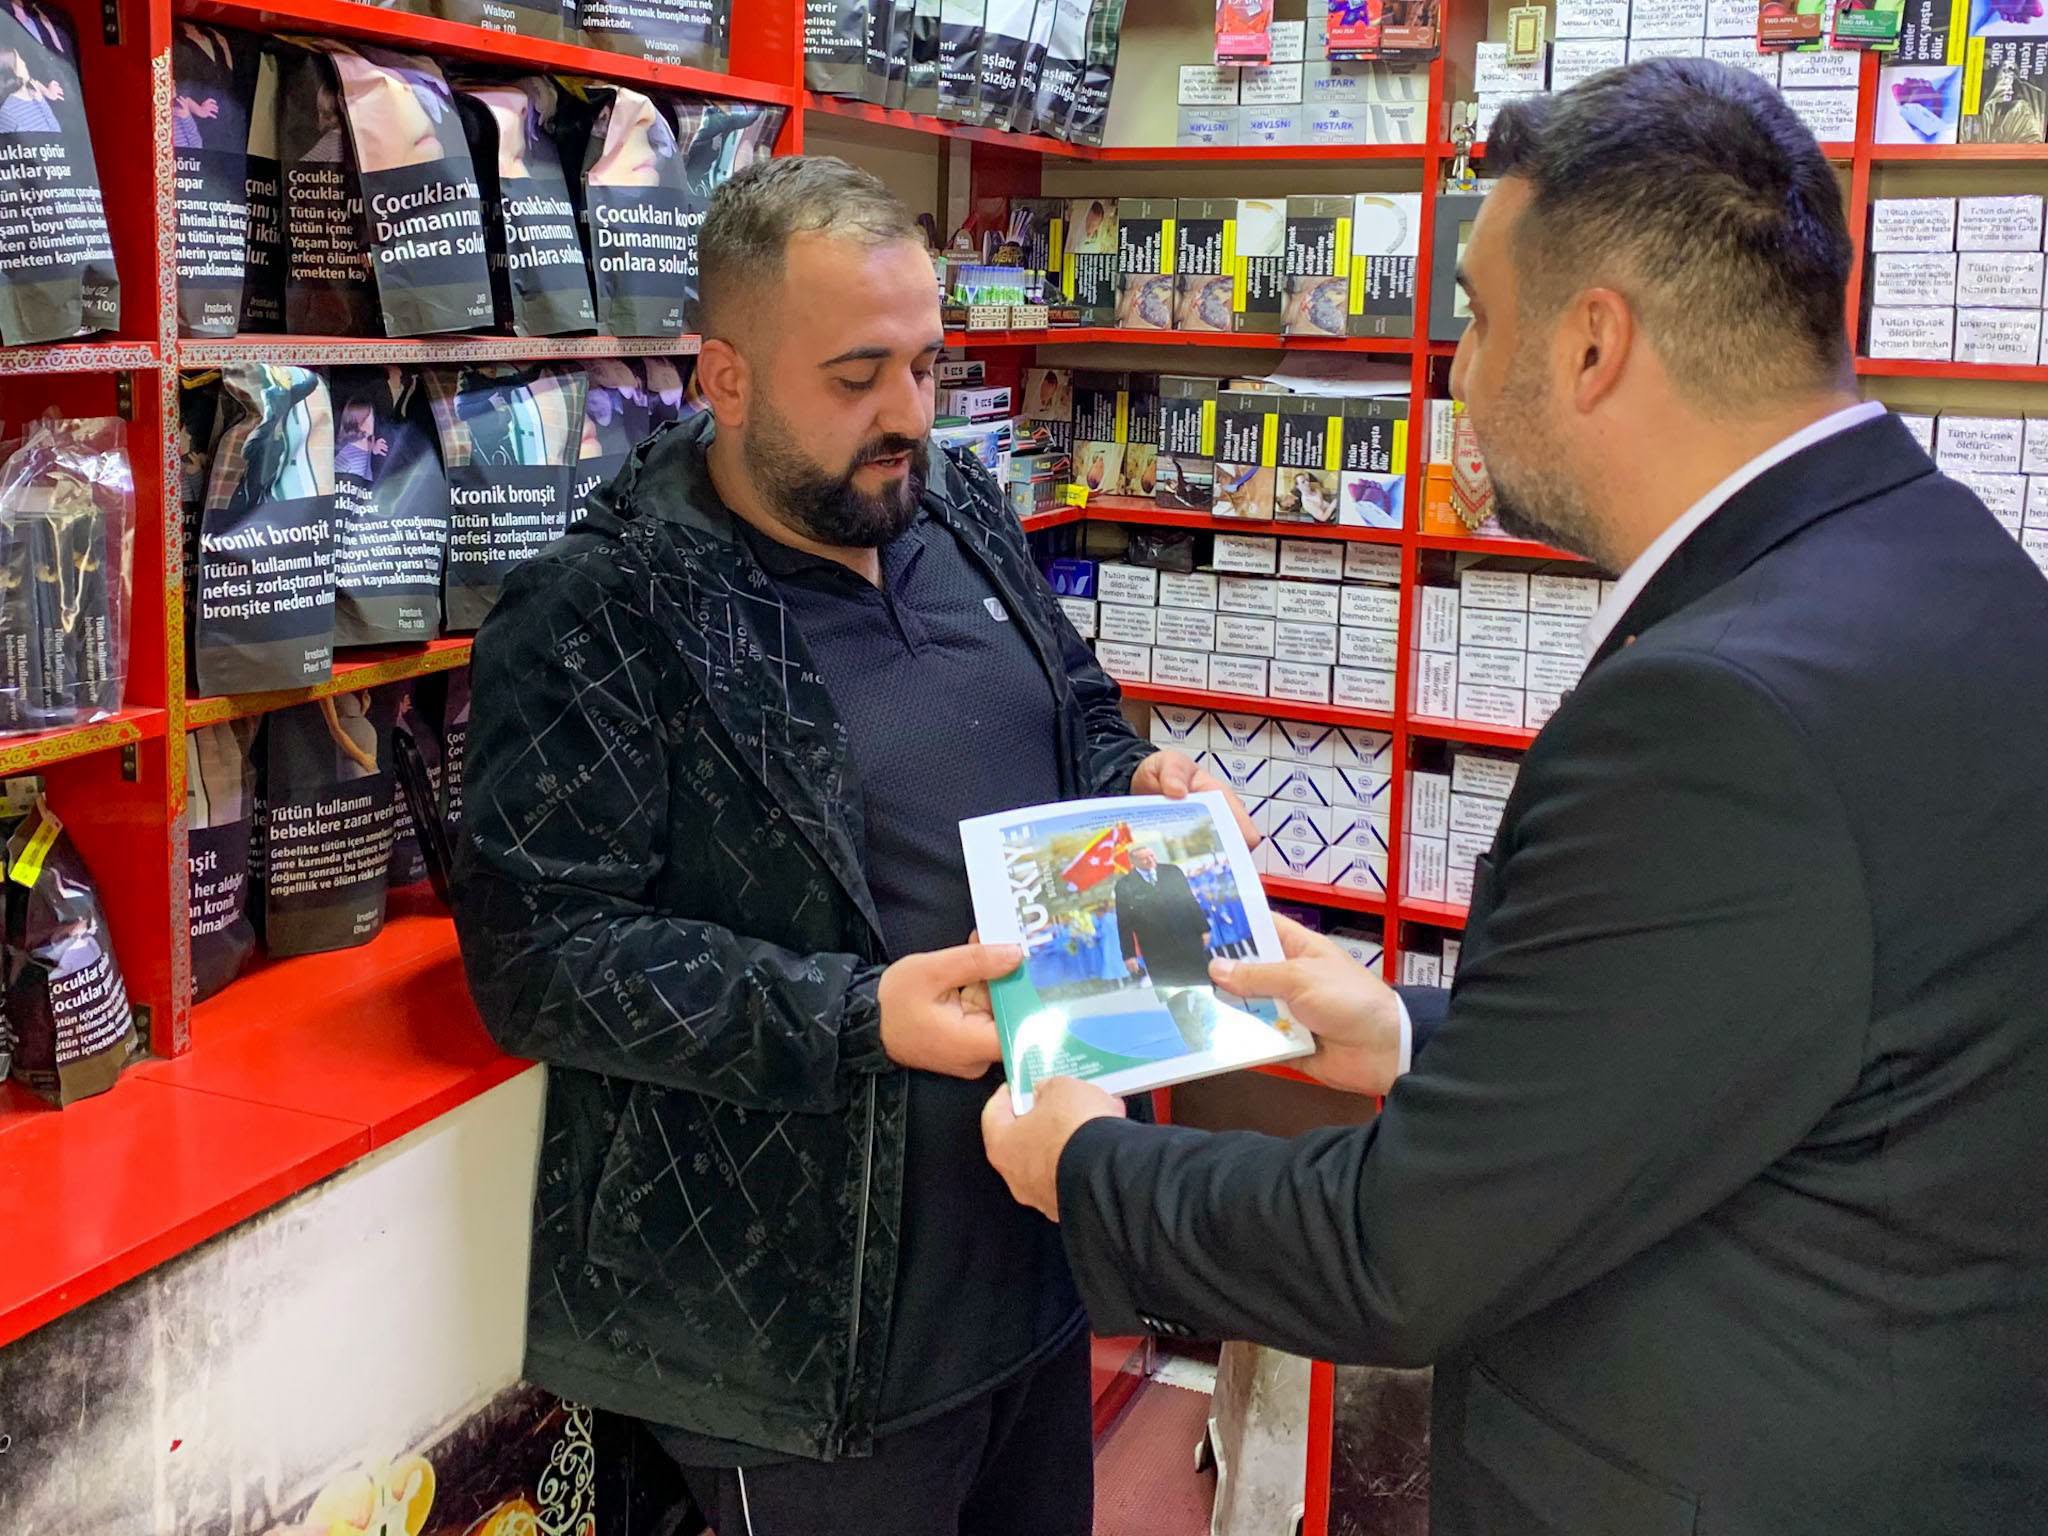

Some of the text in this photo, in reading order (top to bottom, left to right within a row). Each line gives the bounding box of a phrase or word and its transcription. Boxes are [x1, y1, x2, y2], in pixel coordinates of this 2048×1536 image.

[483, 4, 515, 19] Watson
[807, 3, 838, 13] verir
[583, 16, 634, 30] olmaktadır.
[645, 40, 679, 52] Watson
[288, 169, 344, 186] Çocuklar
[288, 187, 345, 202] Çocuklar
[289, 206, 324, 220] Tütün
[595, 203, 673, 228] Çocukları
[289, 222, 323, 235] tütün
[290, 236, 329, 254] Yaşam
[598, 228, 687, 251] Dumanınızı
[291, 253, 324, 265] erken
[381, 239, 452, 263] onlara
[510, 245, 560, 270] onlara
[599, 251, 656, 272] onlara
[291, 267, 346, 281] içmekten
[450, 484, 556, 507] Kronik bronşit
[451, 514, 488, 528] Tütün
[491, 512, 540, 527] kullanımı
[201, 520, 330, 554] Kronik bronşit
[450, 529, 548, 546] nefesi zorlaştıran
[451, 548, 506, 565] bronşite
[203, 563, 248, 580] Tütün
[252, 555, 312, 575] kullanımı
[203, 573, 327, 600] nefesi zorlaştıran
[203, 594, 314, 620] bronşite neden
[271, 796, 372, 822] Tütün kullanımı
[270, 820, 341, 841] bebeklere
[344, 813, 372, 830] zarar
[271, 845, 319, 859] Gebelikte
[271, 861, 296, 872] anne
[298, 853, 341, 868] karnında
[271, 871, 306, 884] doğum
[309, 867, 343, 879] sonrası
[195, 883, 216, 898] her
